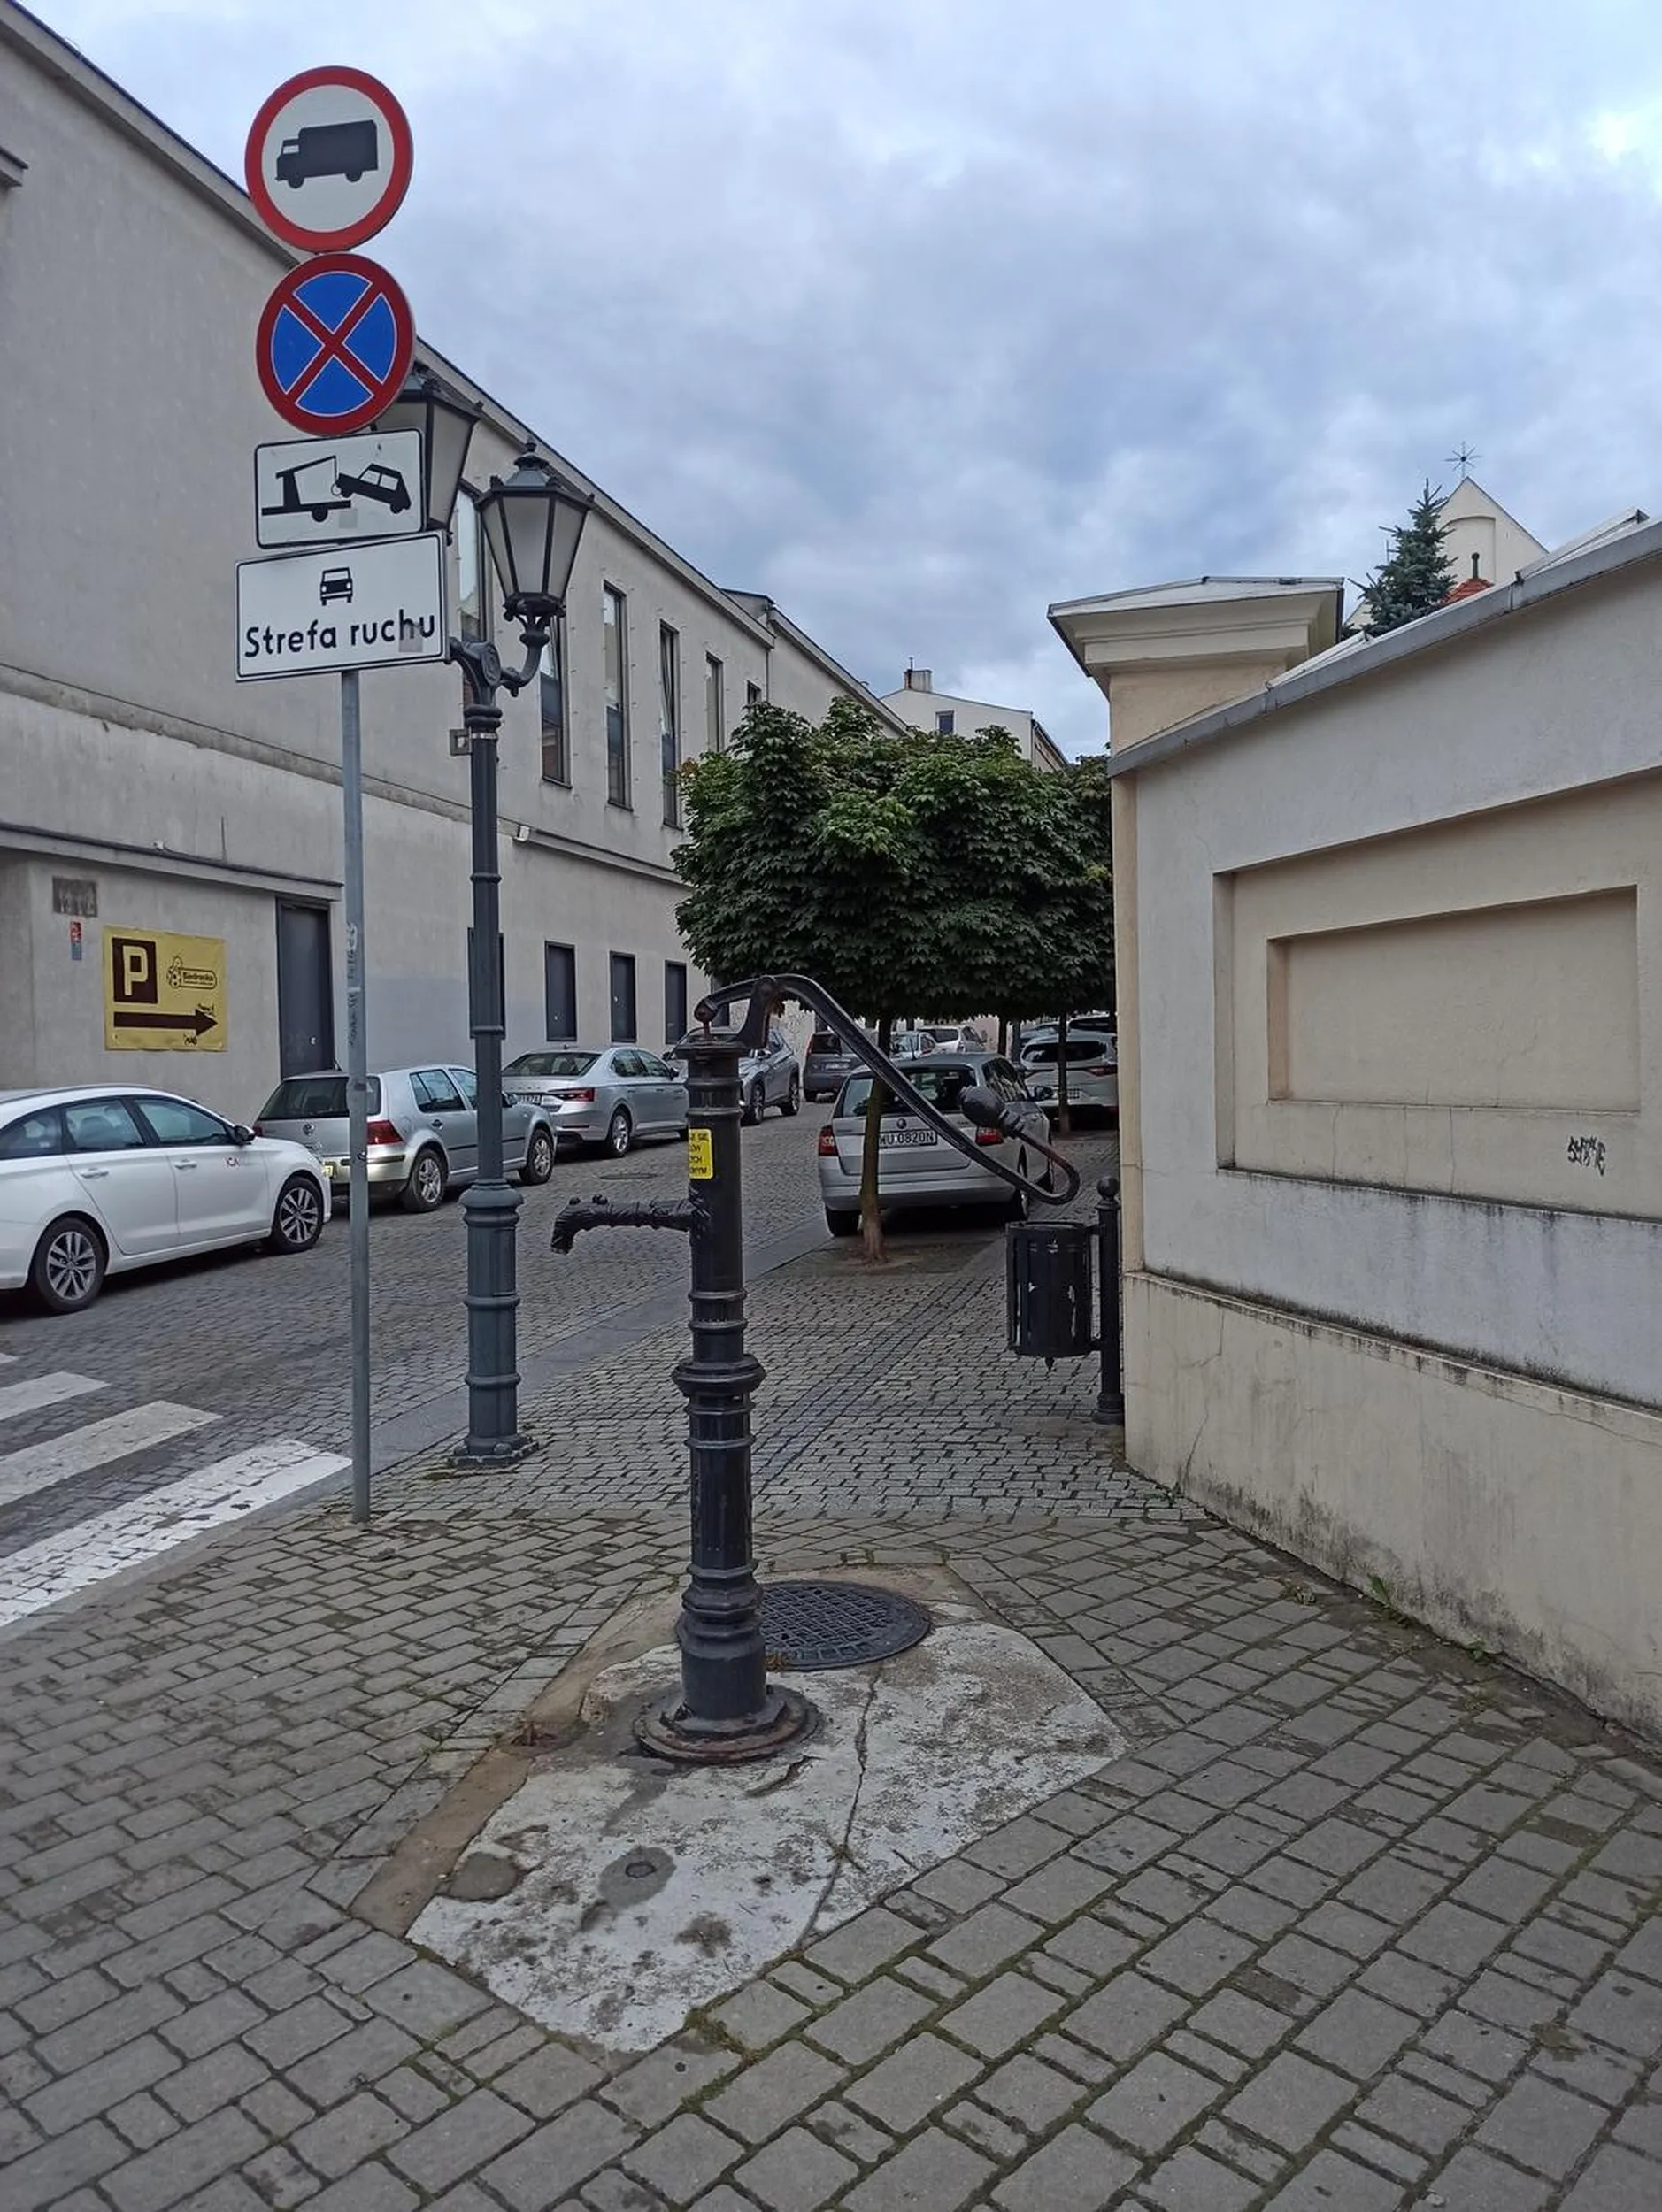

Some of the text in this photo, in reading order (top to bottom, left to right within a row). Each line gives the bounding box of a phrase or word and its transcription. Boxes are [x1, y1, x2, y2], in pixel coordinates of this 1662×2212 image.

[244, 609, 435, 657] Strefa ruchu
[122, 944, 149, 996] P
